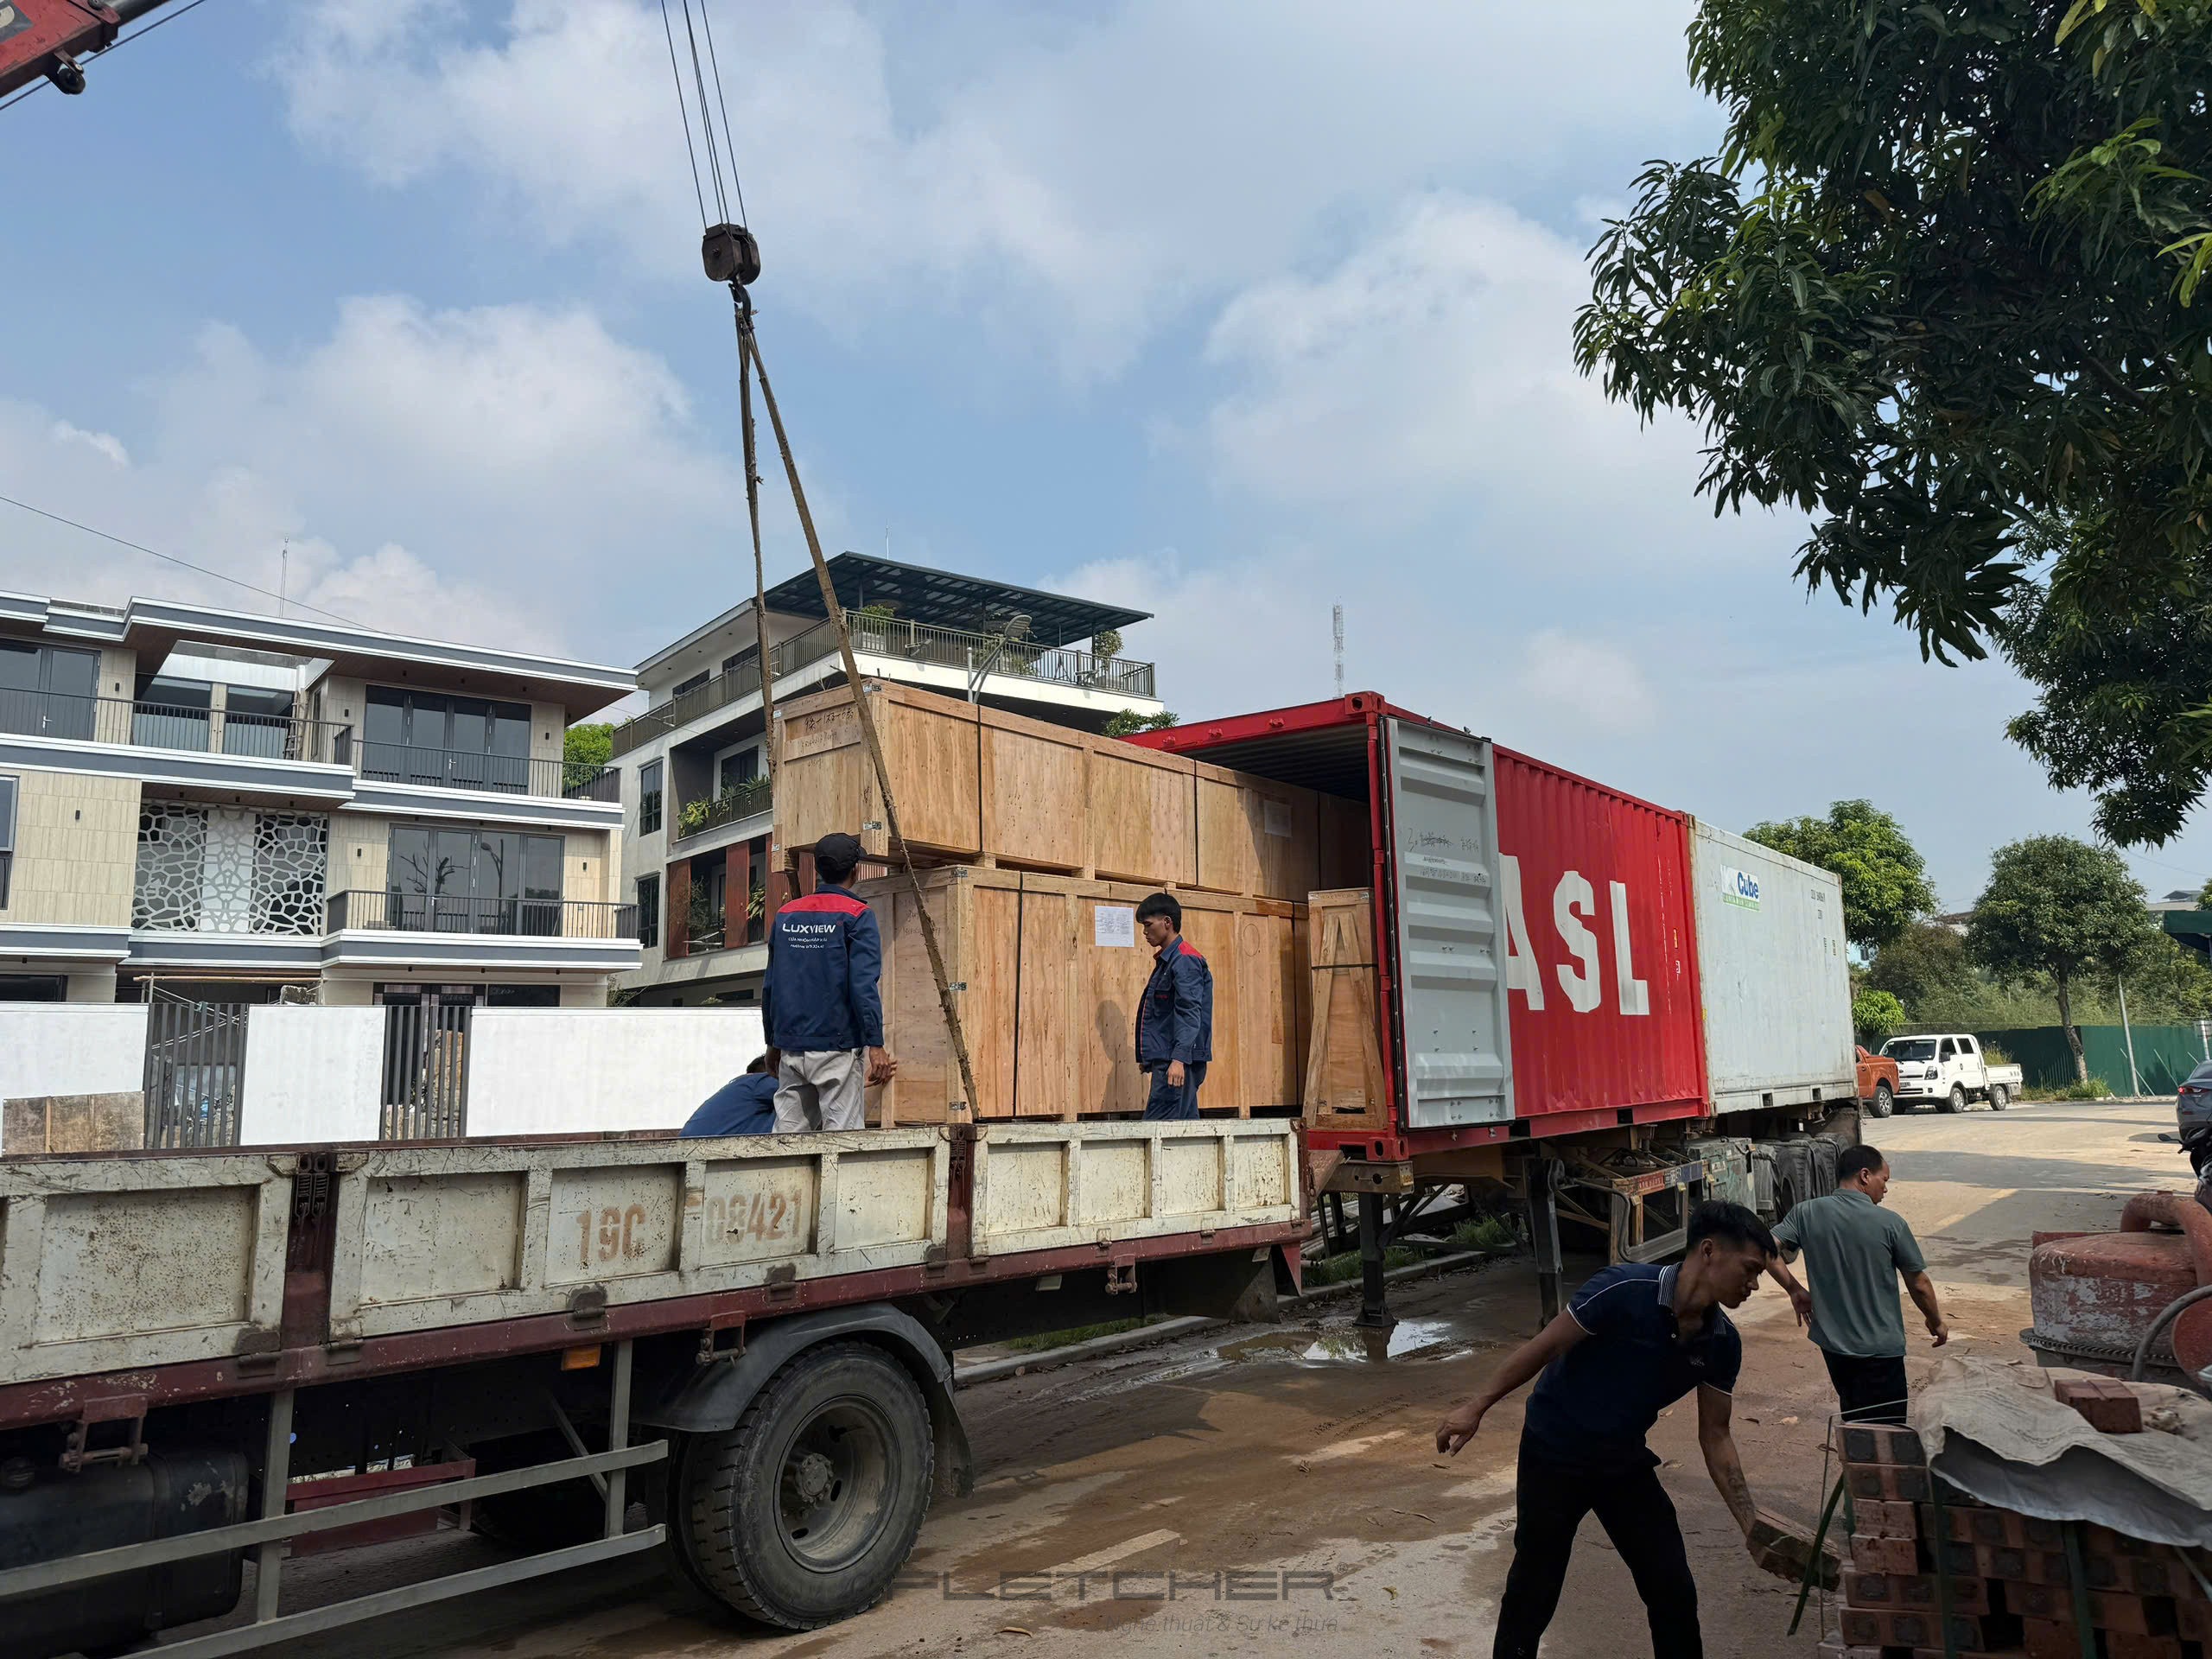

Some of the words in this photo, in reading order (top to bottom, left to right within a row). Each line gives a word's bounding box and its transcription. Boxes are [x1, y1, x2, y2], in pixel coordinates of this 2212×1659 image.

[1738, 872, 1759, 899] Cube
[782, 923, 836, 934] LUXVIEW
[576, 1203, 646, 1263] 19C
